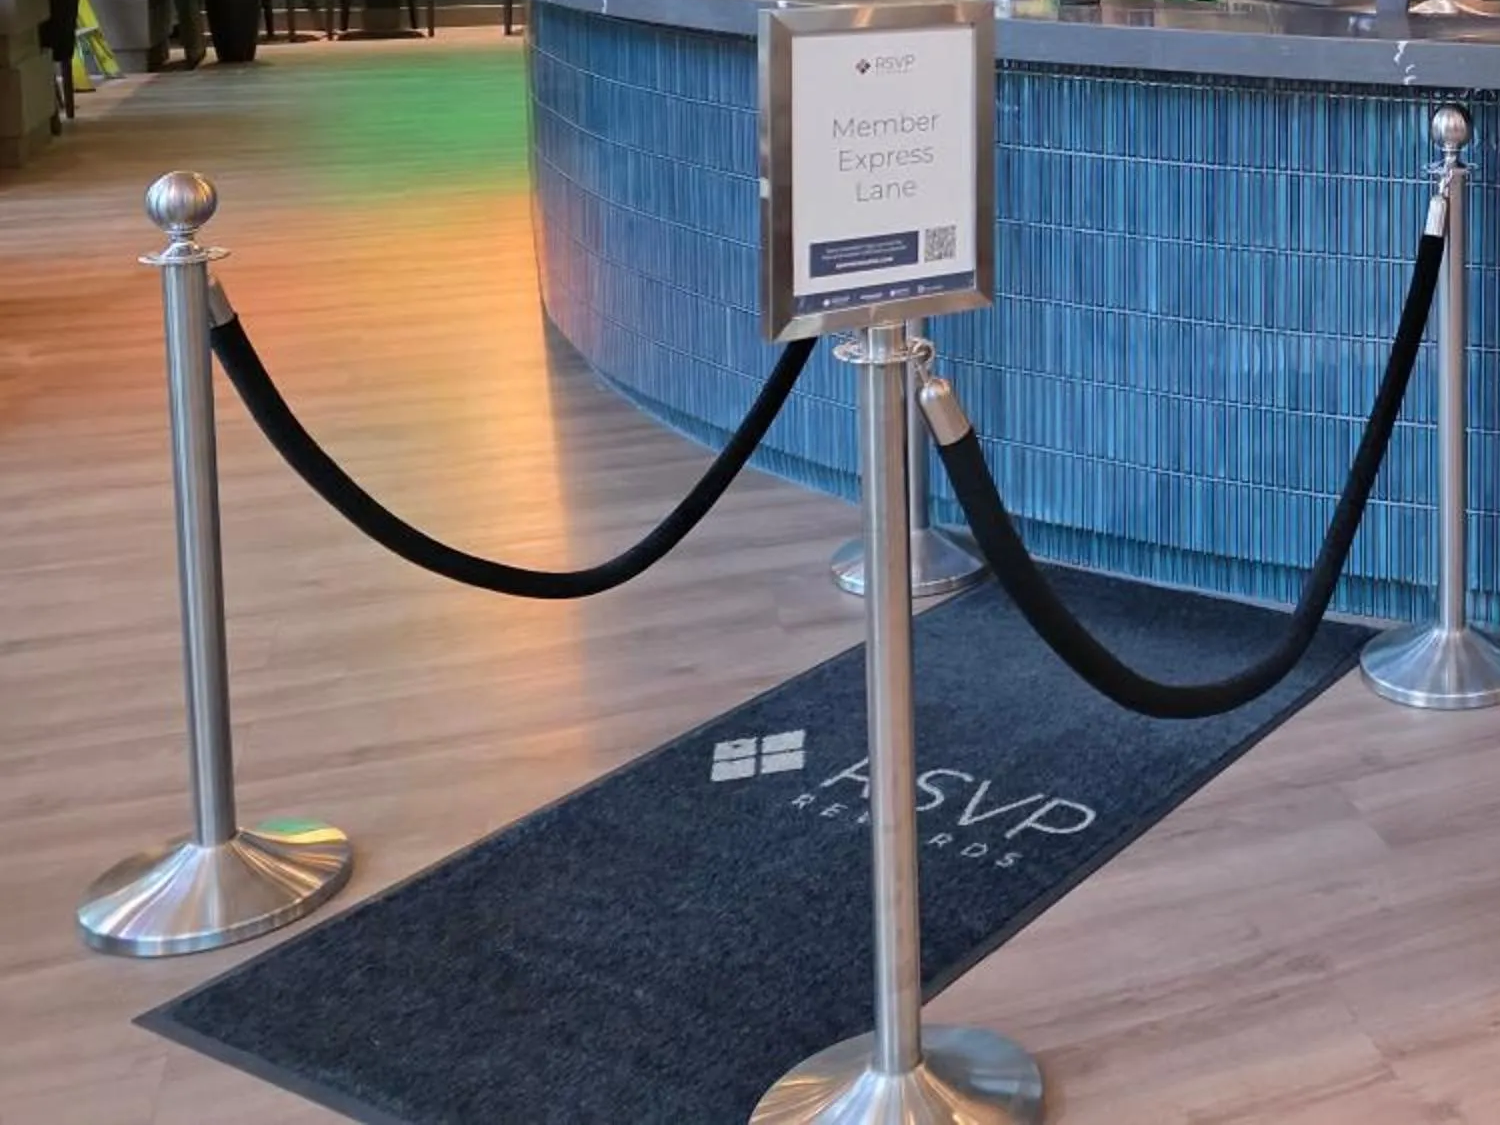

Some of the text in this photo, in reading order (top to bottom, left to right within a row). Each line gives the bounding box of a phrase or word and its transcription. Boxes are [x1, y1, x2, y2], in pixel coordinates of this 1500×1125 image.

[833, 114, 941, 138] Member
[839, 146, 934, 173] Express
[856, 179, 917, 202] Lane
[792, 793, 1024, 868] RERDS
